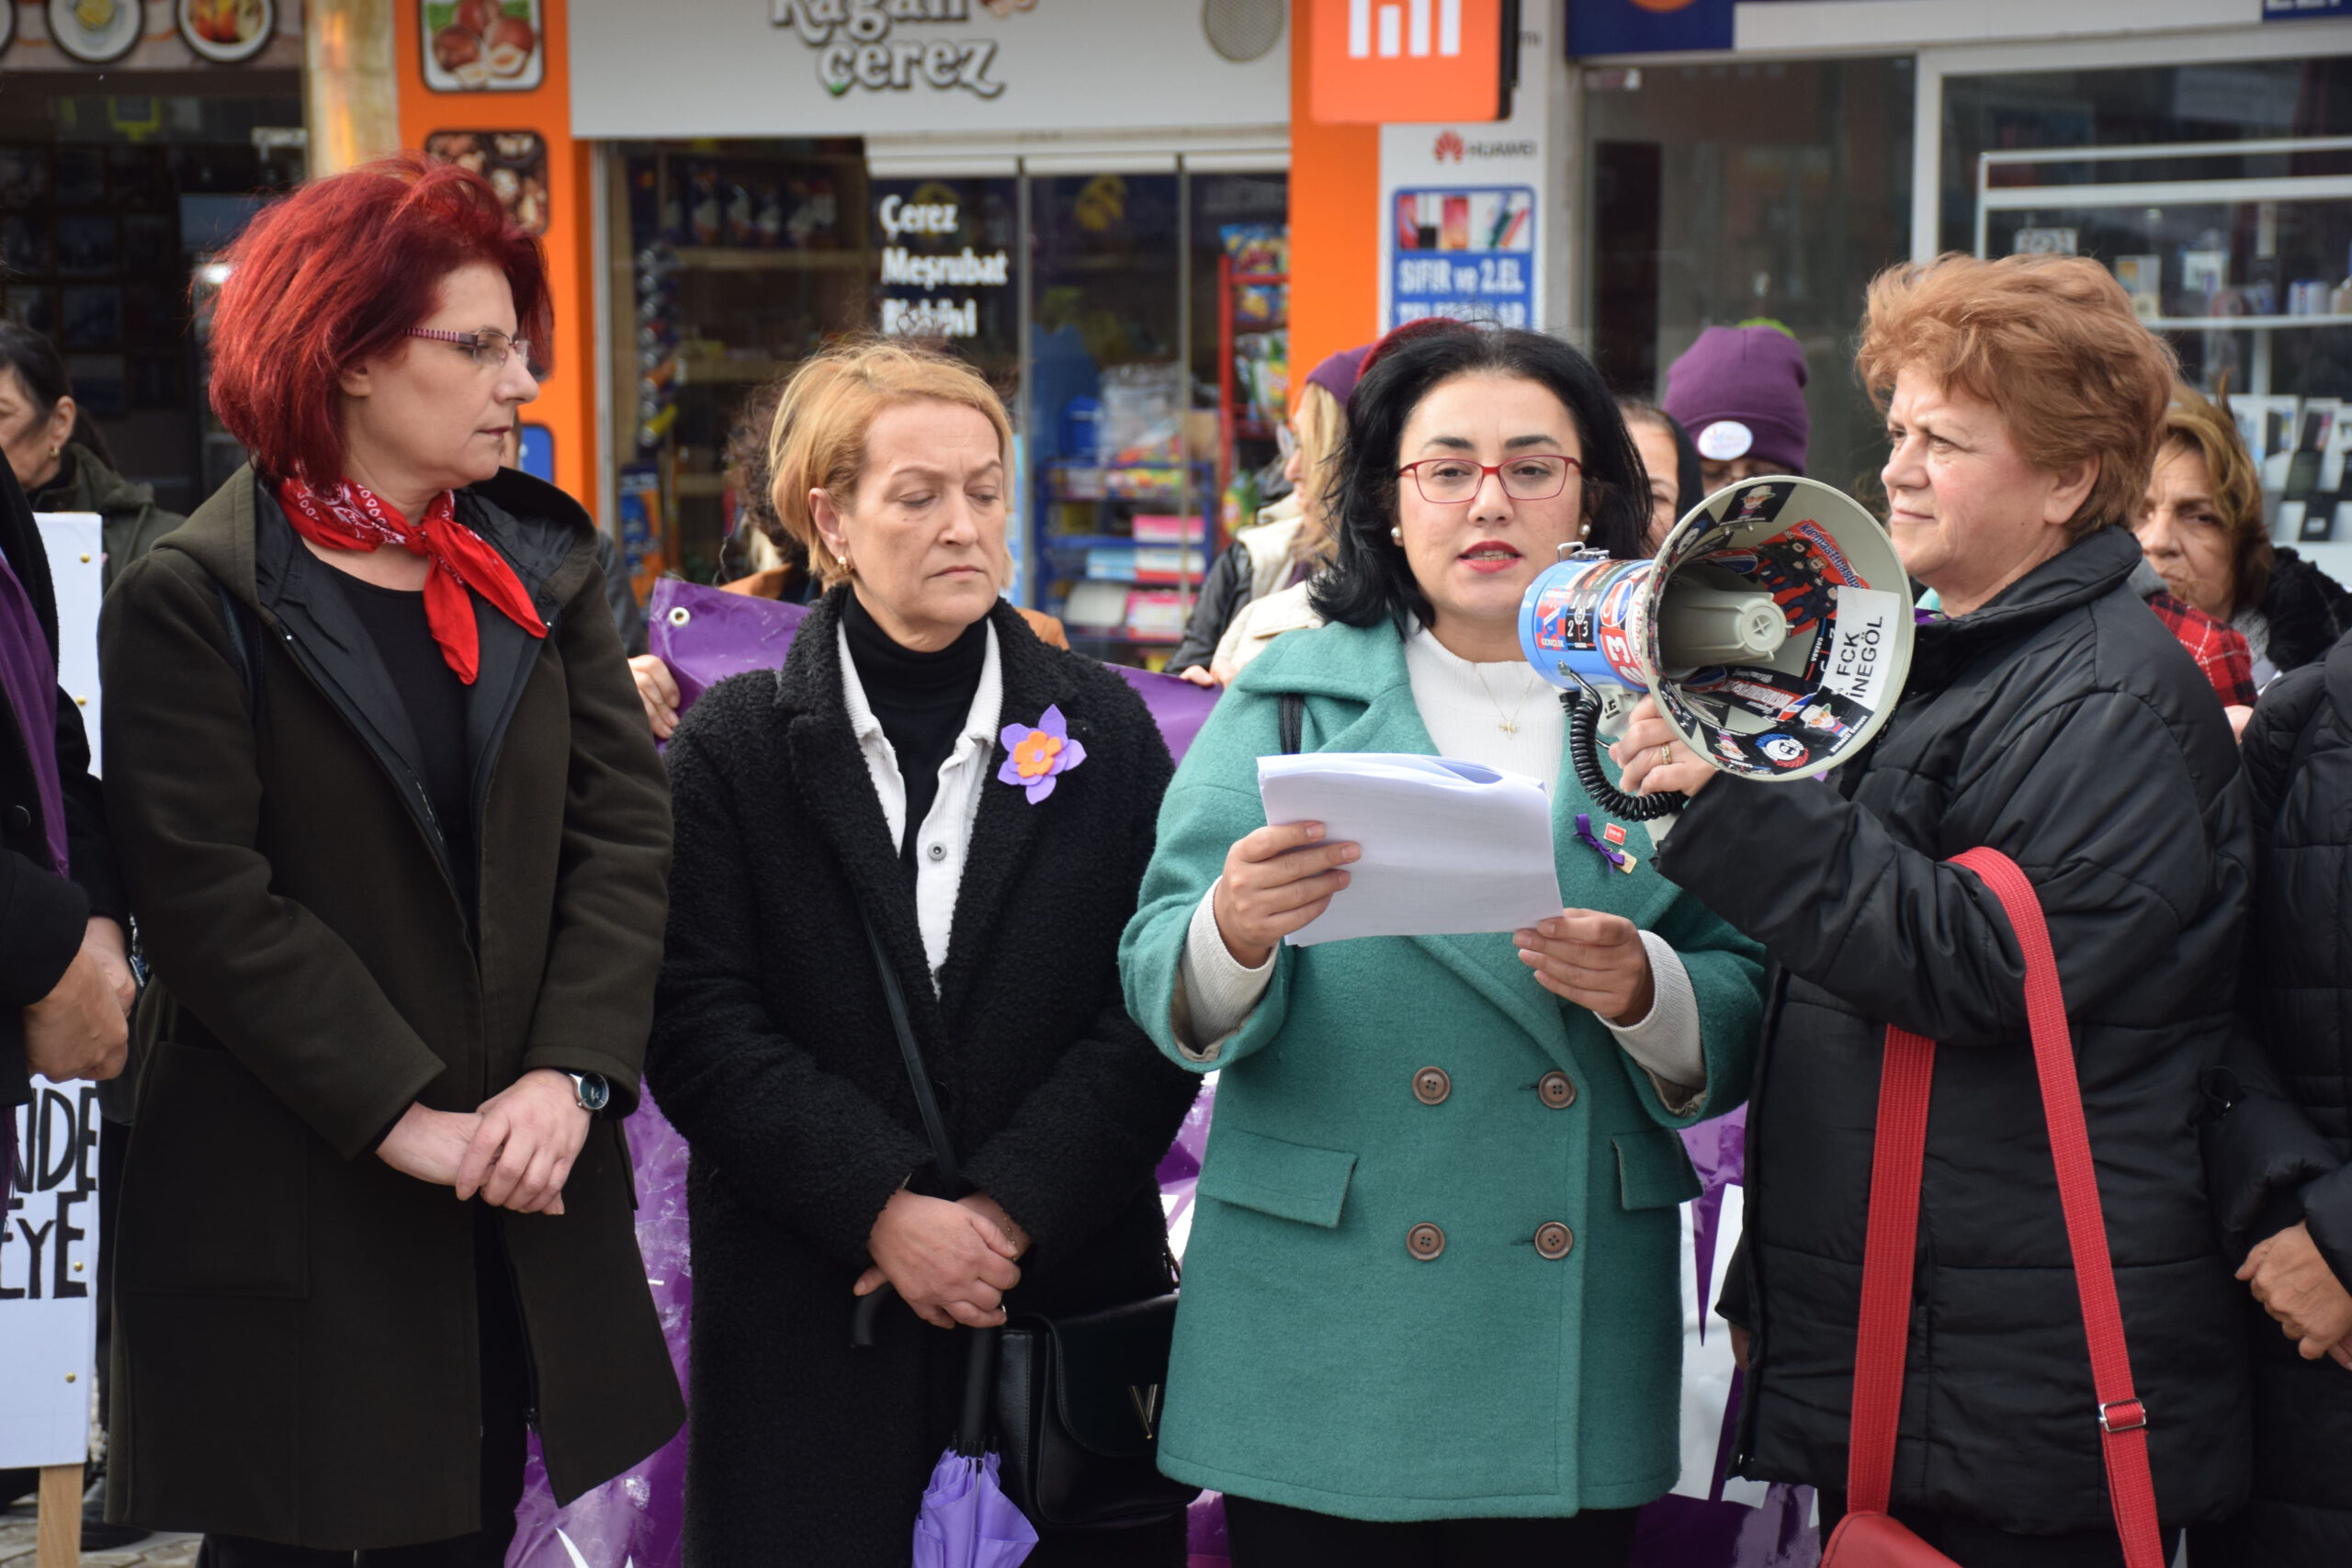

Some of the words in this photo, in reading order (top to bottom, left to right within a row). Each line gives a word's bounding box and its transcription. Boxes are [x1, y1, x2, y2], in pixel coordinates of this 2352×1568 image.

[1468, 141, 1536, 157] HUAWEI
[879, 194, 959, 241] Çerez
[880, 246, 1009, 291] Meşrubat
[1837, 632, 1860, 676] FCK
[1845, 616, 1883, 698] İNEGÖL
